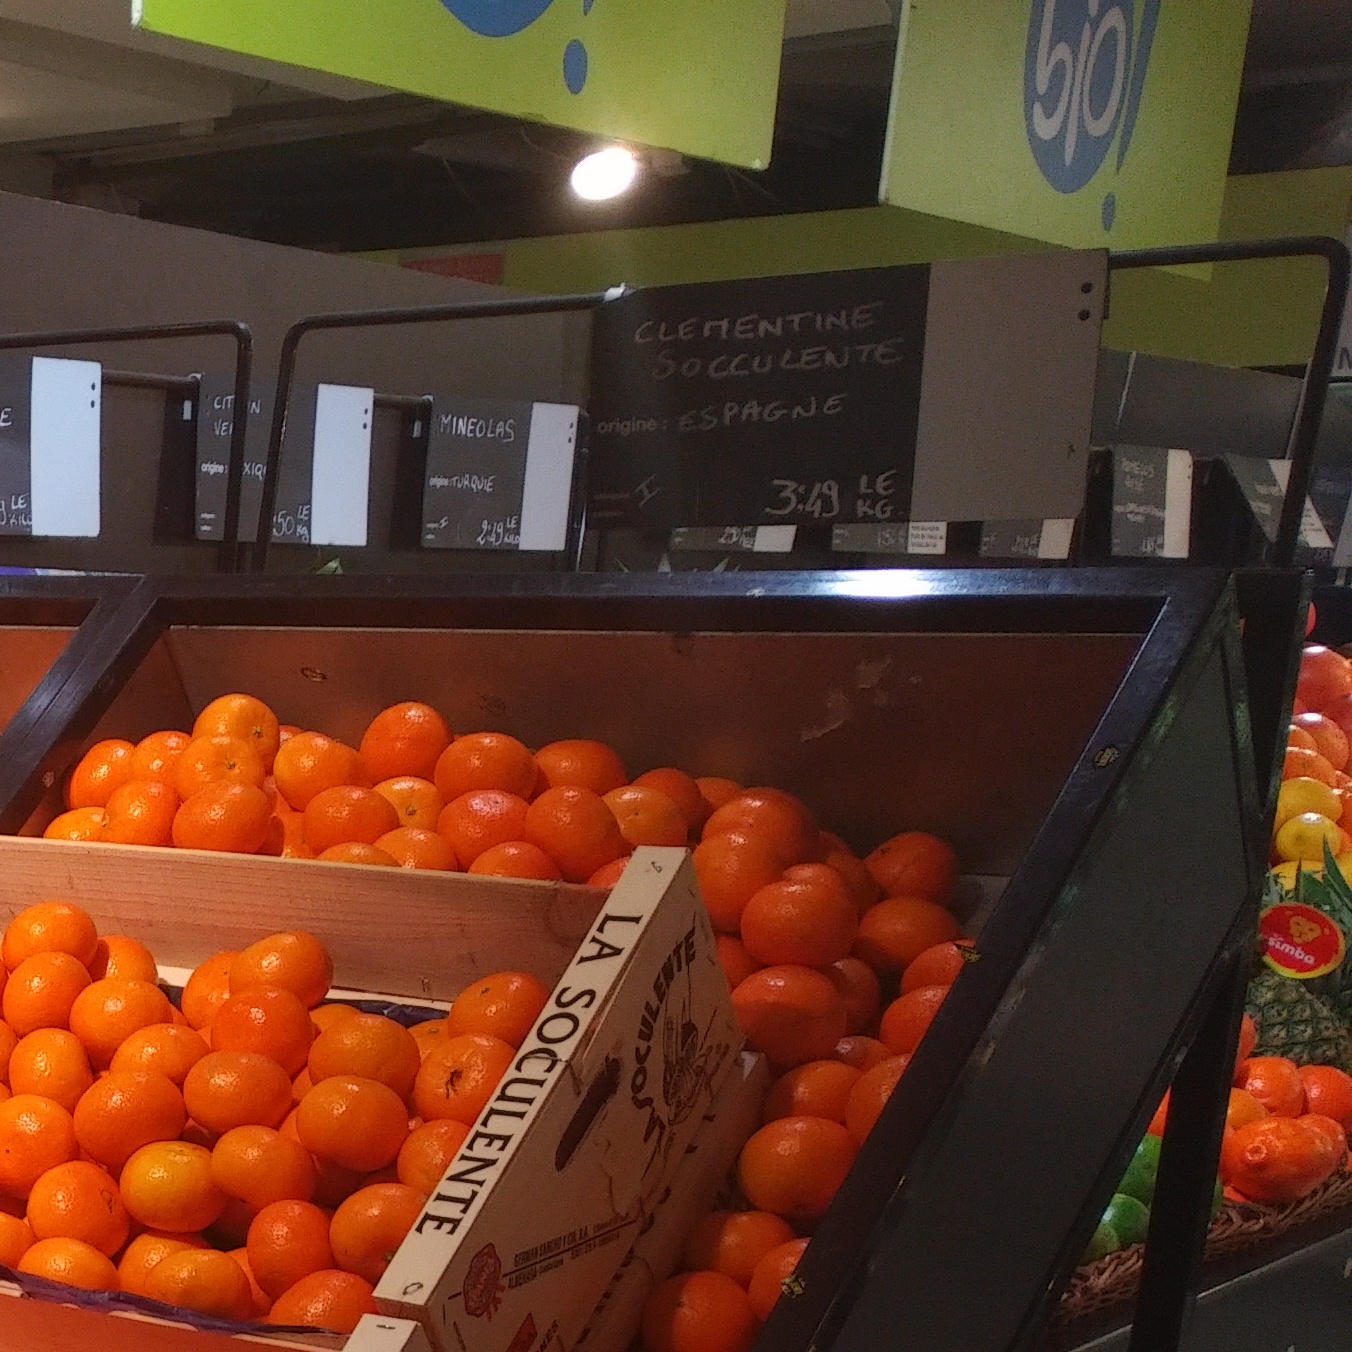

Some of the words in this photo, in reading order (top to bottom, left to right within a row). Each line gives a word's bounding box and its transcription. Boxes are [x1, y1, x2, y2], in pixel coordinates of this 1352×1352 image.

[634, 302, 883, 343] CLEMENTINE
[651, 338, 904, 381] SOCCULENTE
[439, 413, 516, 443] MINEOLAS
[678, 393, 847, 432] ESPAGNE
[452, 473, 496, 492] TURQUIE
[858, 470, 897, 496] LE
[11, 493, 29, 510] LE
[297, 504, 311, 519] LE
[506, 515, 518, 529] LE
[579, 913, 644, 965] LA
[1267, 933, 1316, 965] simba
[630, 915, 696, 1110] SOCULENTE
[415, 985, 596, 1239] SOCULENTE
